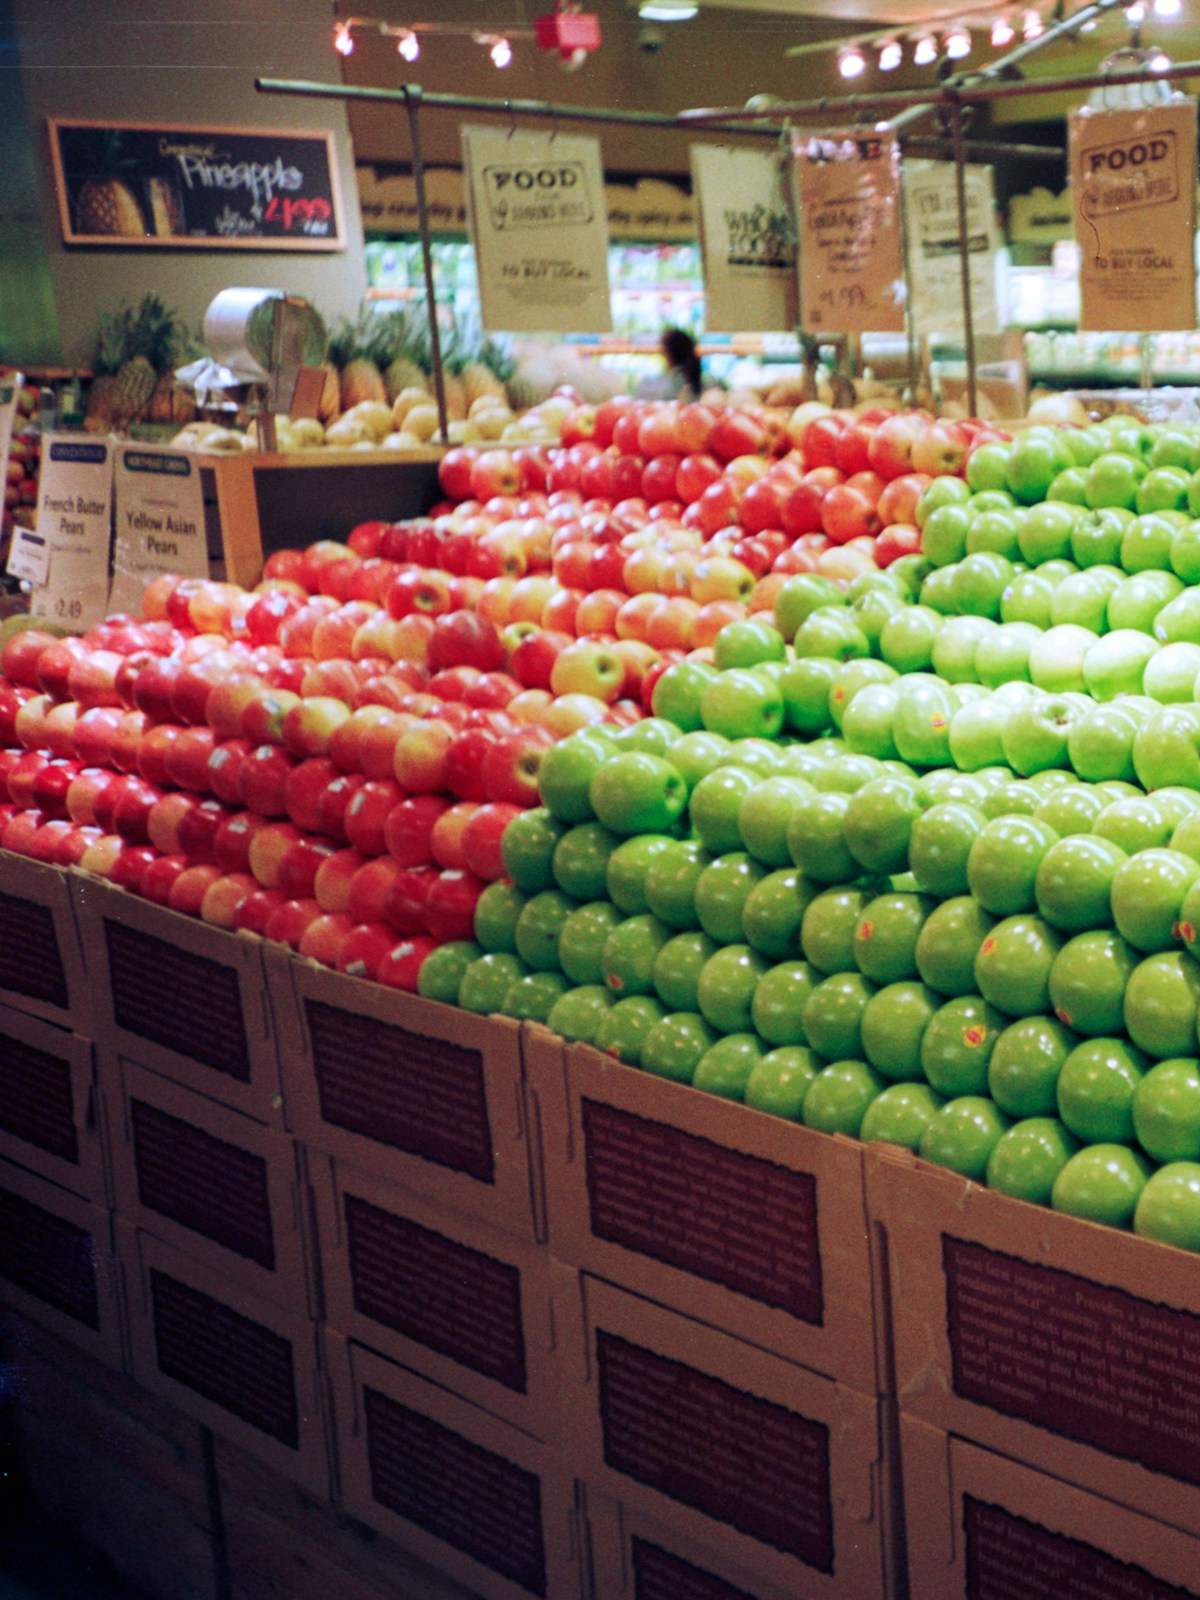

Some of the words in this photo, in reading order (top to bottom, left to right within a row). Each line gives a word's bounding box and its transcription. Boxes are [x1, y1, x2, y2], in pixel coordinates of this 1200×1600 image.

[1090, 140, 1169, 173] FOOD
[493, 167, 577, 190] FOOD
[44, 495, 75, 515] French
[78, 497, 105, 516] Butter
[60, 517, 85, 535] Pears
[127, 511, 163, 532] Yellow
[166, 516, 197, 537] Asian
[147, 536, 178, 556] Pears
